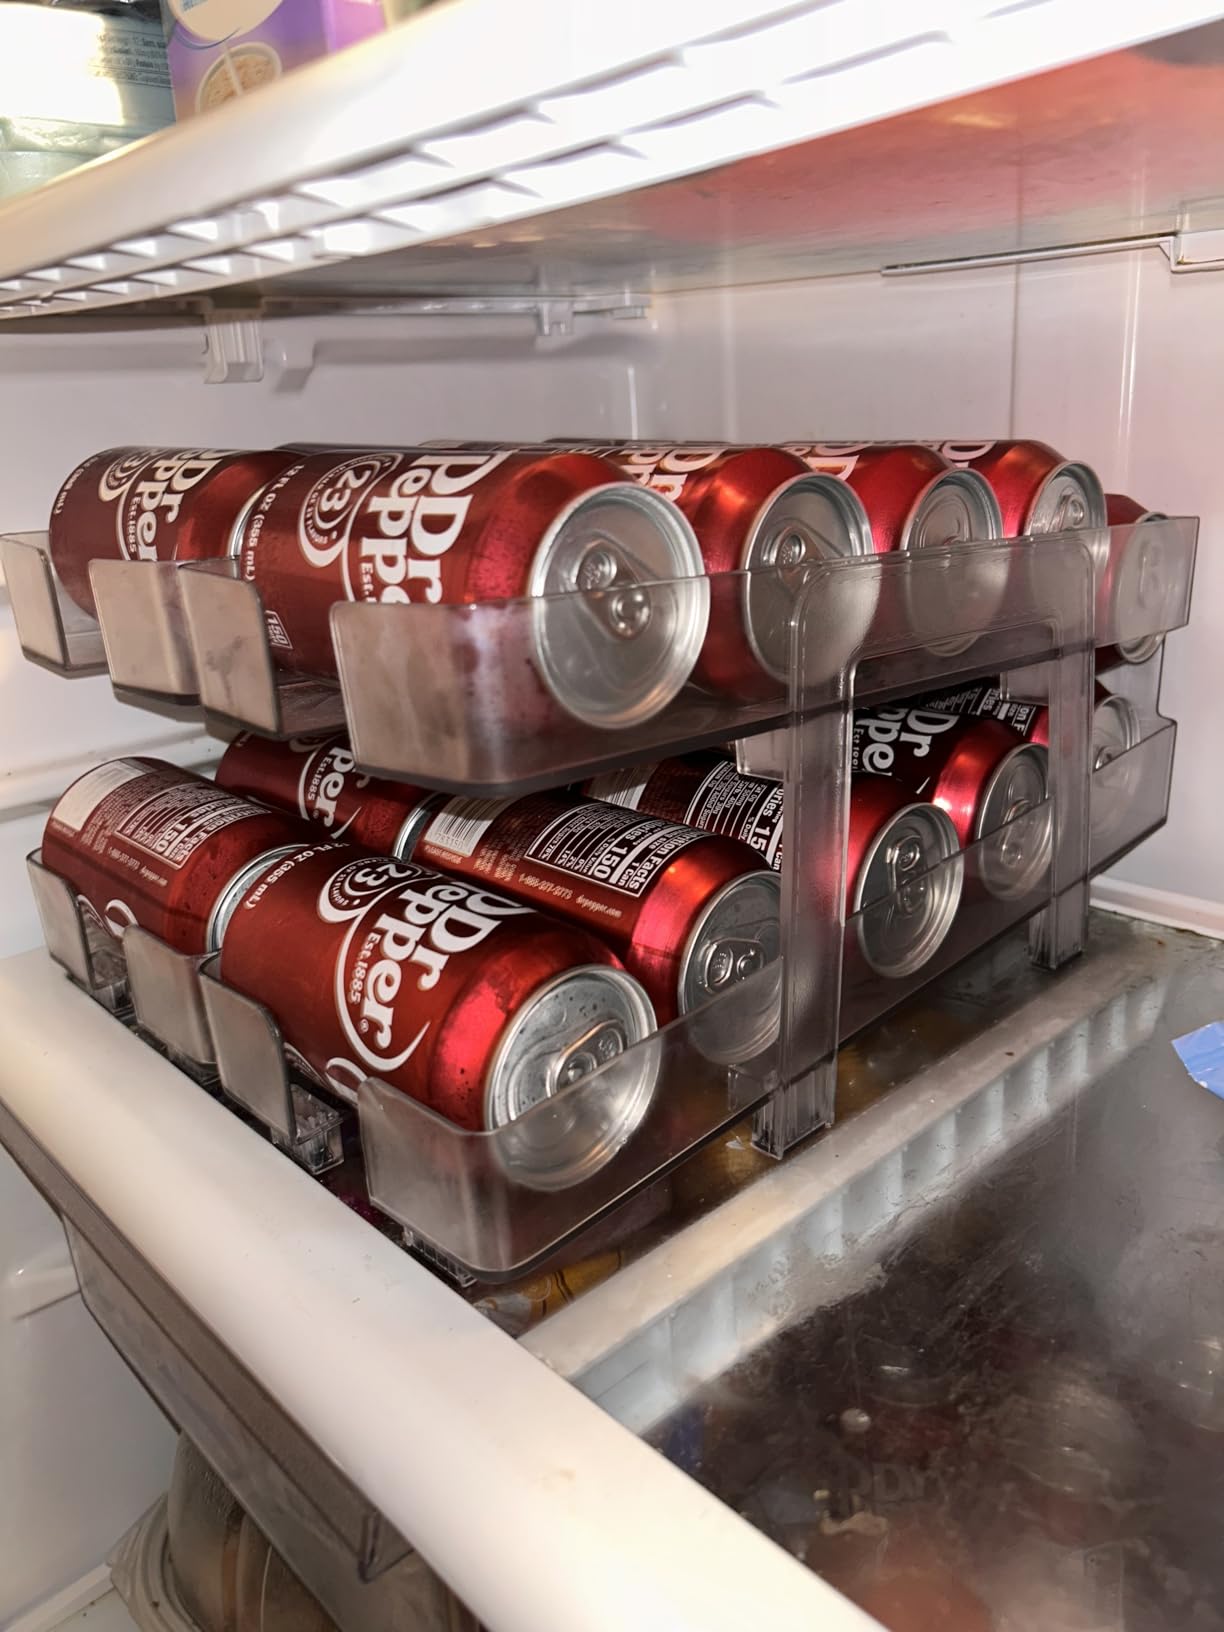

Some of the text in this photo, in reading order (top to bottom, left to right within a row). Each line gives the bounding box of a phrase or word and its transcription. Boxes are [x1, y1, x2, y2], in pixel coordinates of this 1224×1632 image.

[942, 440, 997, 468] D
[159, 459, 222, 523] Dr
[258, 493, 276, 512] OZ
[320, 469, 372, 512] 23
[249, 514, 265, 547] (355
[360, 448, 515, 604] Pepp
[408, 494, 473, 603] Dr
[245, 551, 256, 580] mL)
[268, 617, 289, 644] 150
[899, 709, 960, 757] Dr
[308, 756, 333, 801] Est.1885
[315, 746, 354, 827] per
[157, 822, 188, 854] 150
[750, 826, 767, 851] 15
[265, 860, 295, 884] (355
[293, 850, 315, 863] OZ
[593, 846, 628, 879] 150
[628, 855, 662, 890] Facts
[355, 863, 413, 887] 23
[618, 868, 634, 886] Can
[243, 883, 269, 909] mL)
[332, 882, 349, 907] FLAVORS
[417, 904, 502, 992] Dr
[350, 932, 382, 1004] Est.1885
[360, 880, 538, 1050] Pepper
